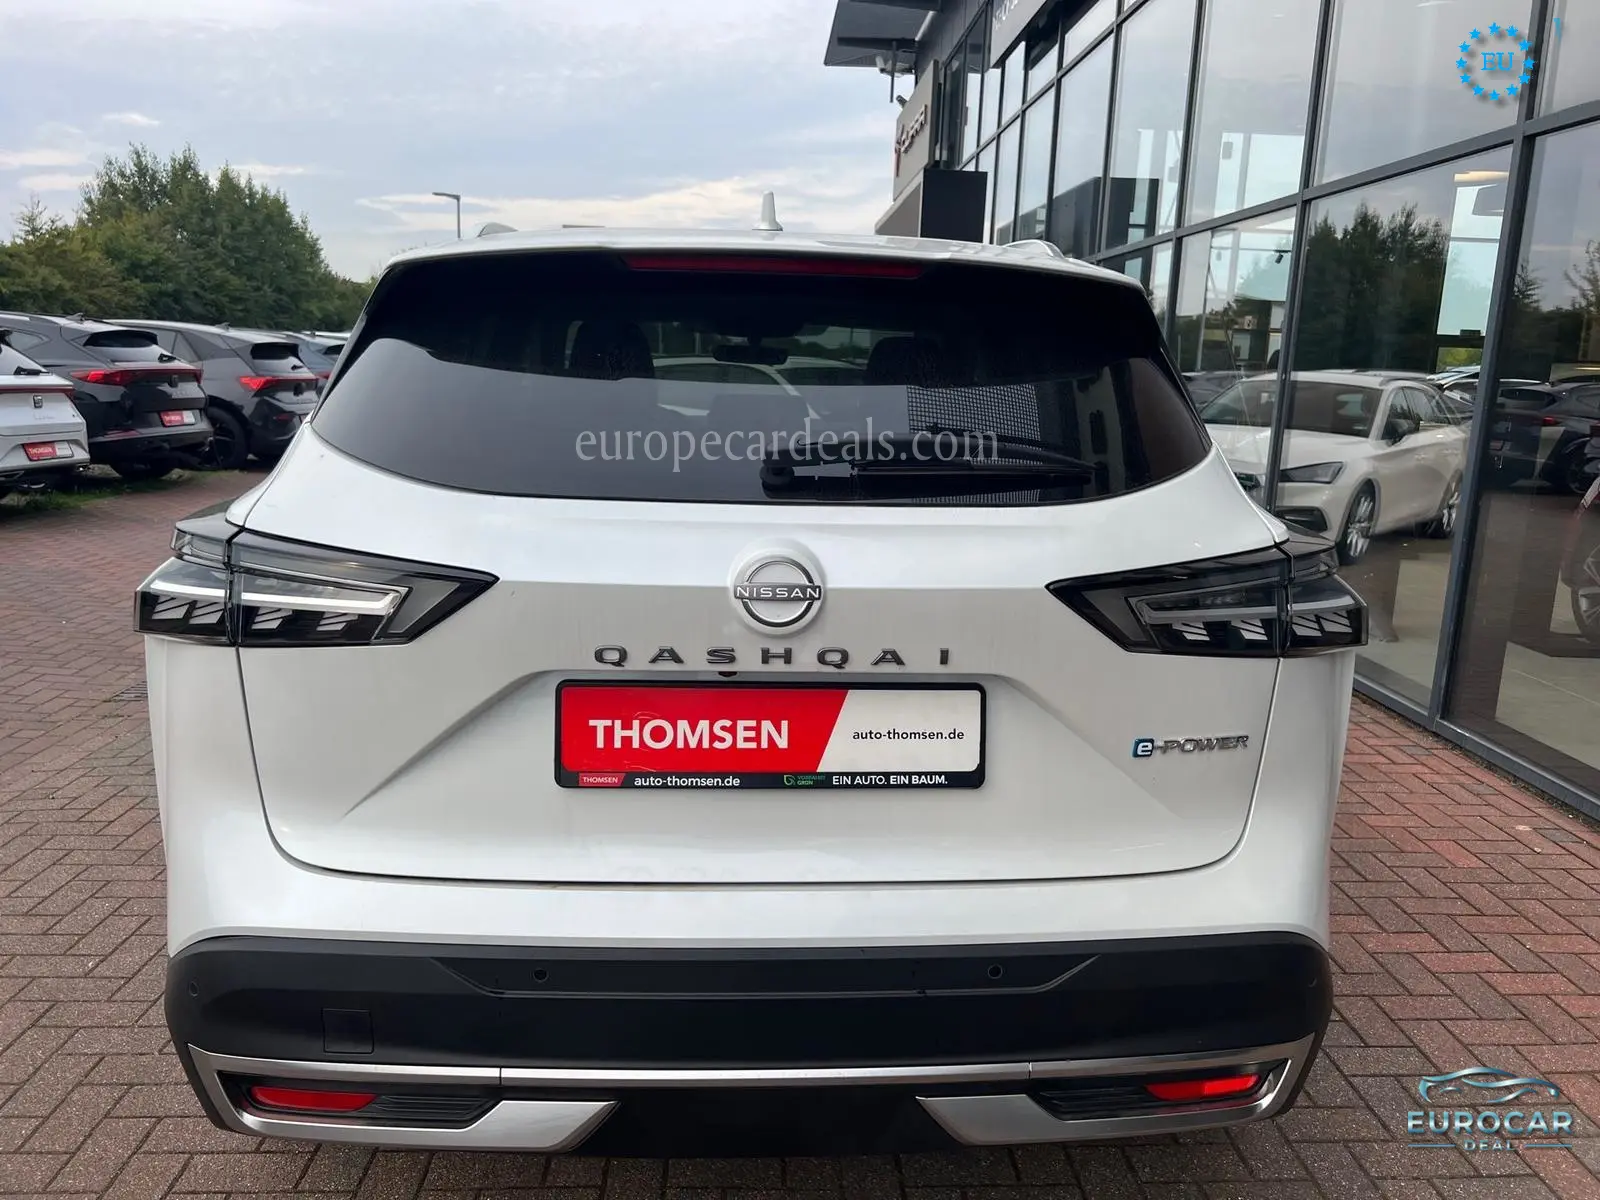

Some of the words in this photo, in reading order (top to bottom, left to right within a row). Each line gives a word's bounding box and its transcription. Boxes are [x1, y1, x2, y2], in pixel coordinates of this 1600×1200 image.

[736, 586, 820, 599] NISSAN
[594, 645, 950, 668] QASHQAI
[588, 719, 790, 750] THOMSEN
[851, 727, 965, 743] auto-thomsen.de
[582, 776, 619, 784] THOMSEN
[634, 776, 741, 786] auto-thomsen.de
[832, 775, 851, 785] EIN
[853, 775, 888, 785] AUTO.
[889, 775, 909, 785] EIN
[911, 775, 948, 785] BAUM.
